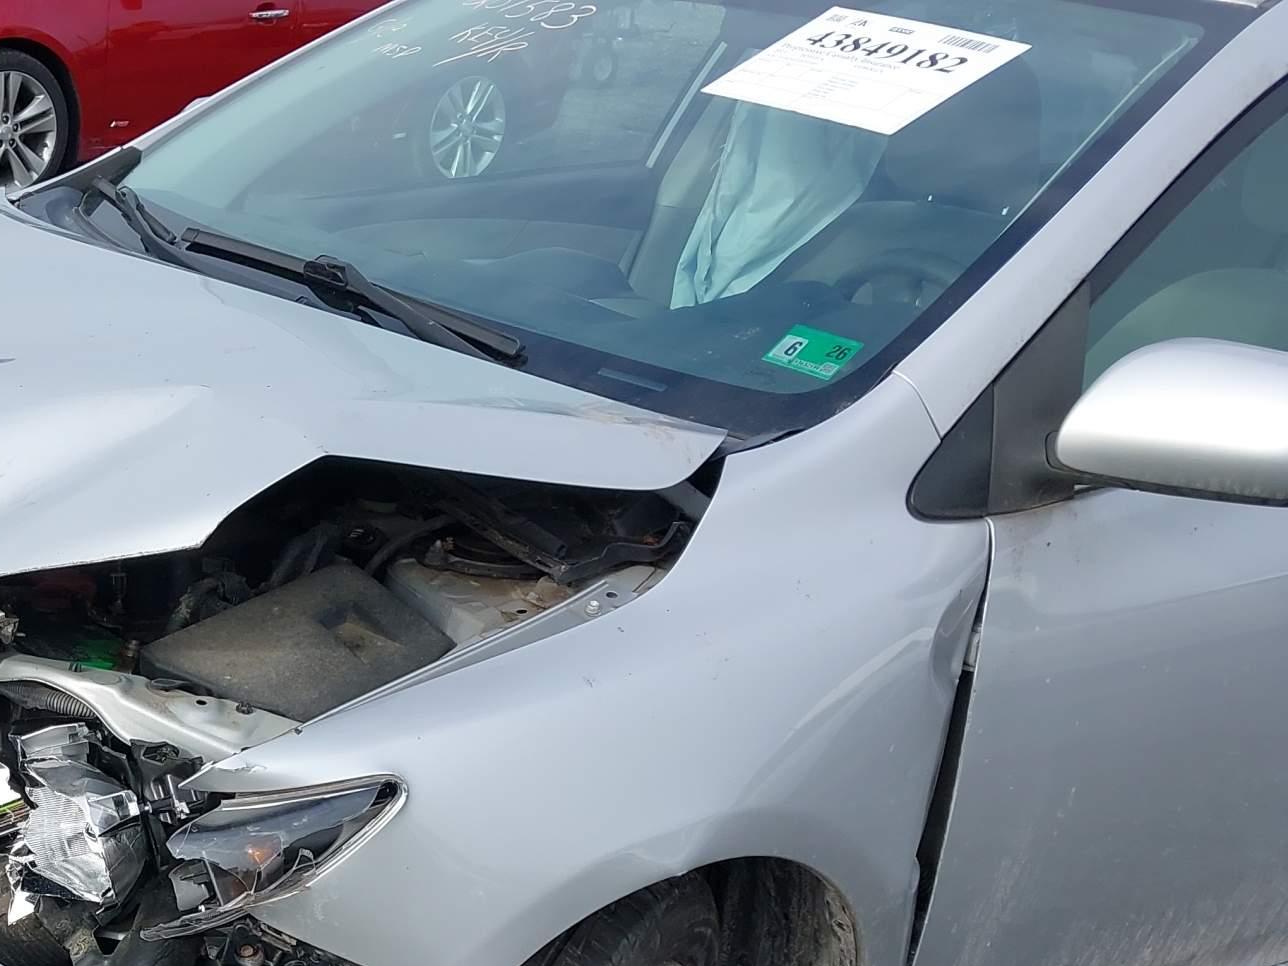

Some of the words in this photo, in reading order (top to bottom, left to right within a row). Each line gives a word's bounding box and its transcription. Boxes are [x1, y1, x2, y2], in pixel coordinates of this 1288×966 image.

[805, 31, 969, 74] 43849182
[783, 341, 803, 357] 6
[825, 344, 852, 361] 26
